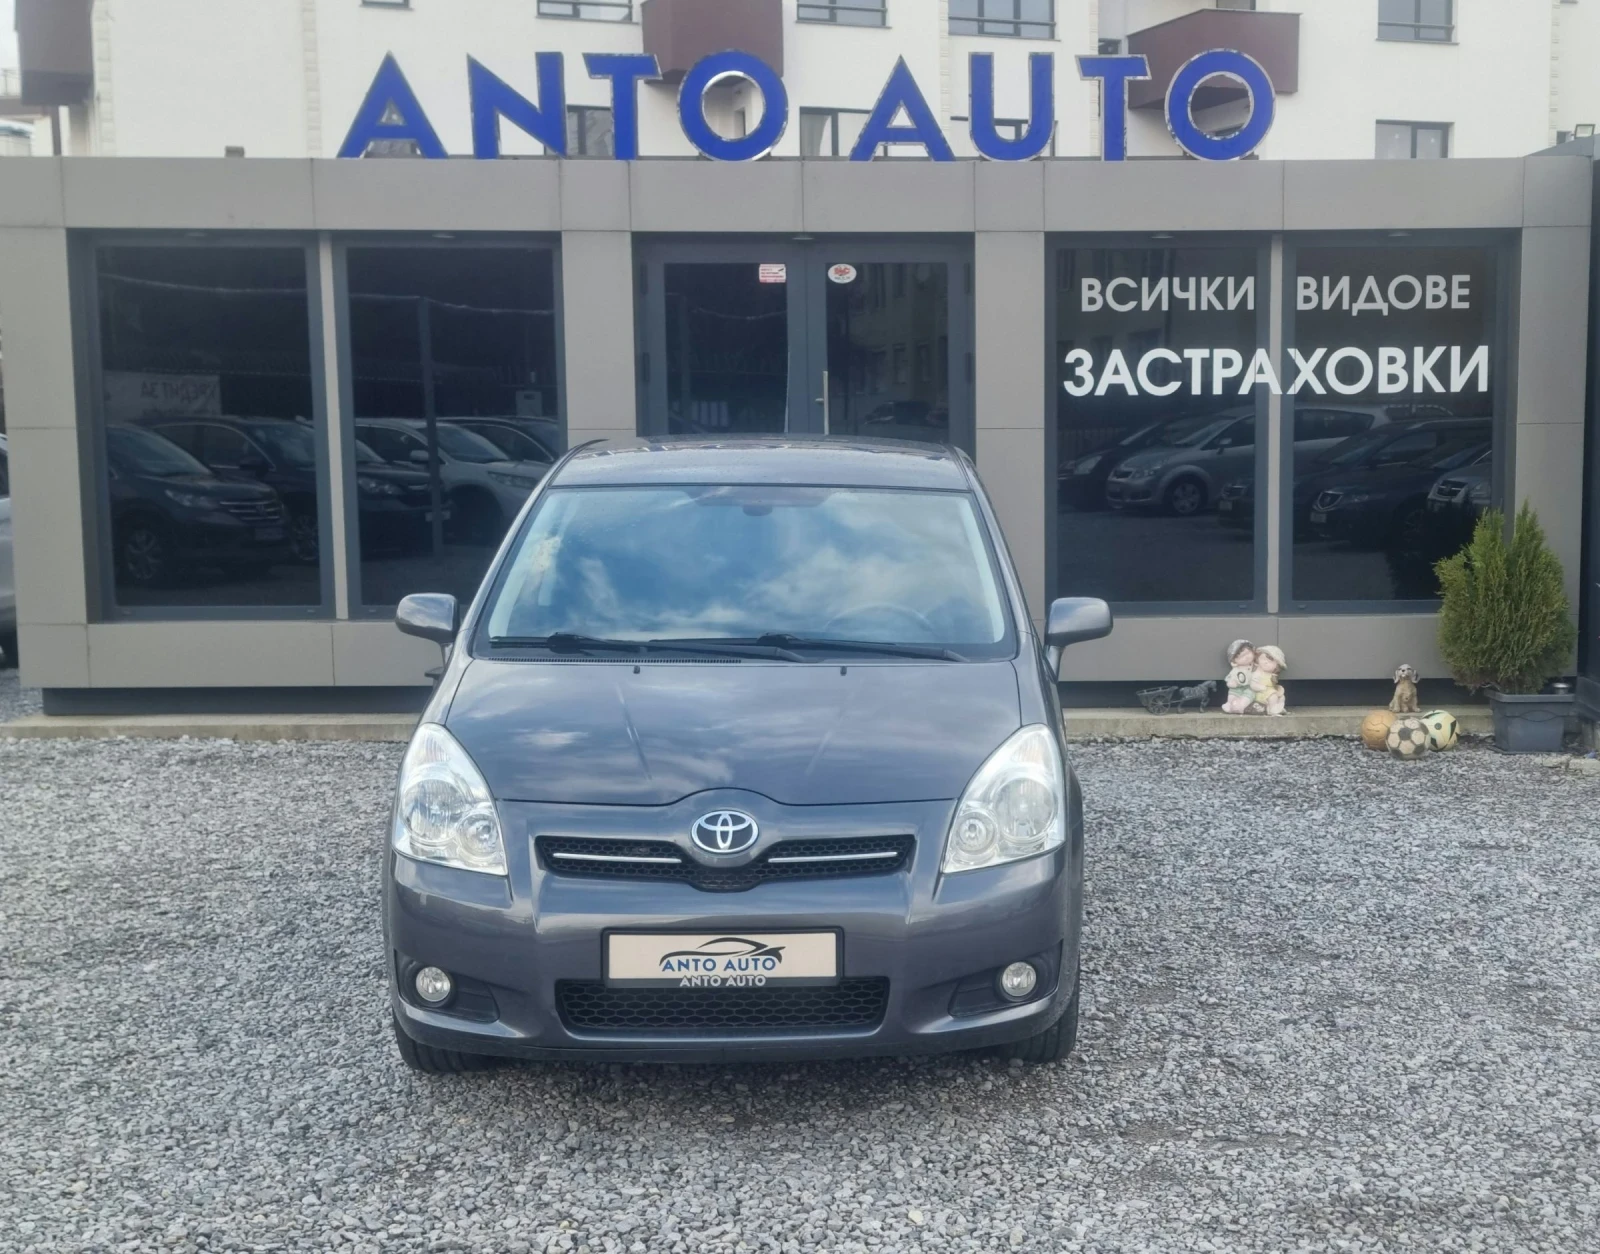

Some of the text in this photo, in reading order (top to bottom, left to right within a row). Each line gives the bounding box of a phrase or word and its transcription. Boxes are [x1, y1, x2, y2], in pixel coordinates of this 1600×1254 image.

[336, 48, 1276, 162] ANTO AUTO
[1080, 274, 1471, 316] ВСИЧКИ ВИДОВЕ
[1063, 345, 1489, 397] ЗАСТРАХОВКИ
[662, 957, 776, 972] ANTO AUTO
[679, 974, 767, 988] ANTO AUTO
